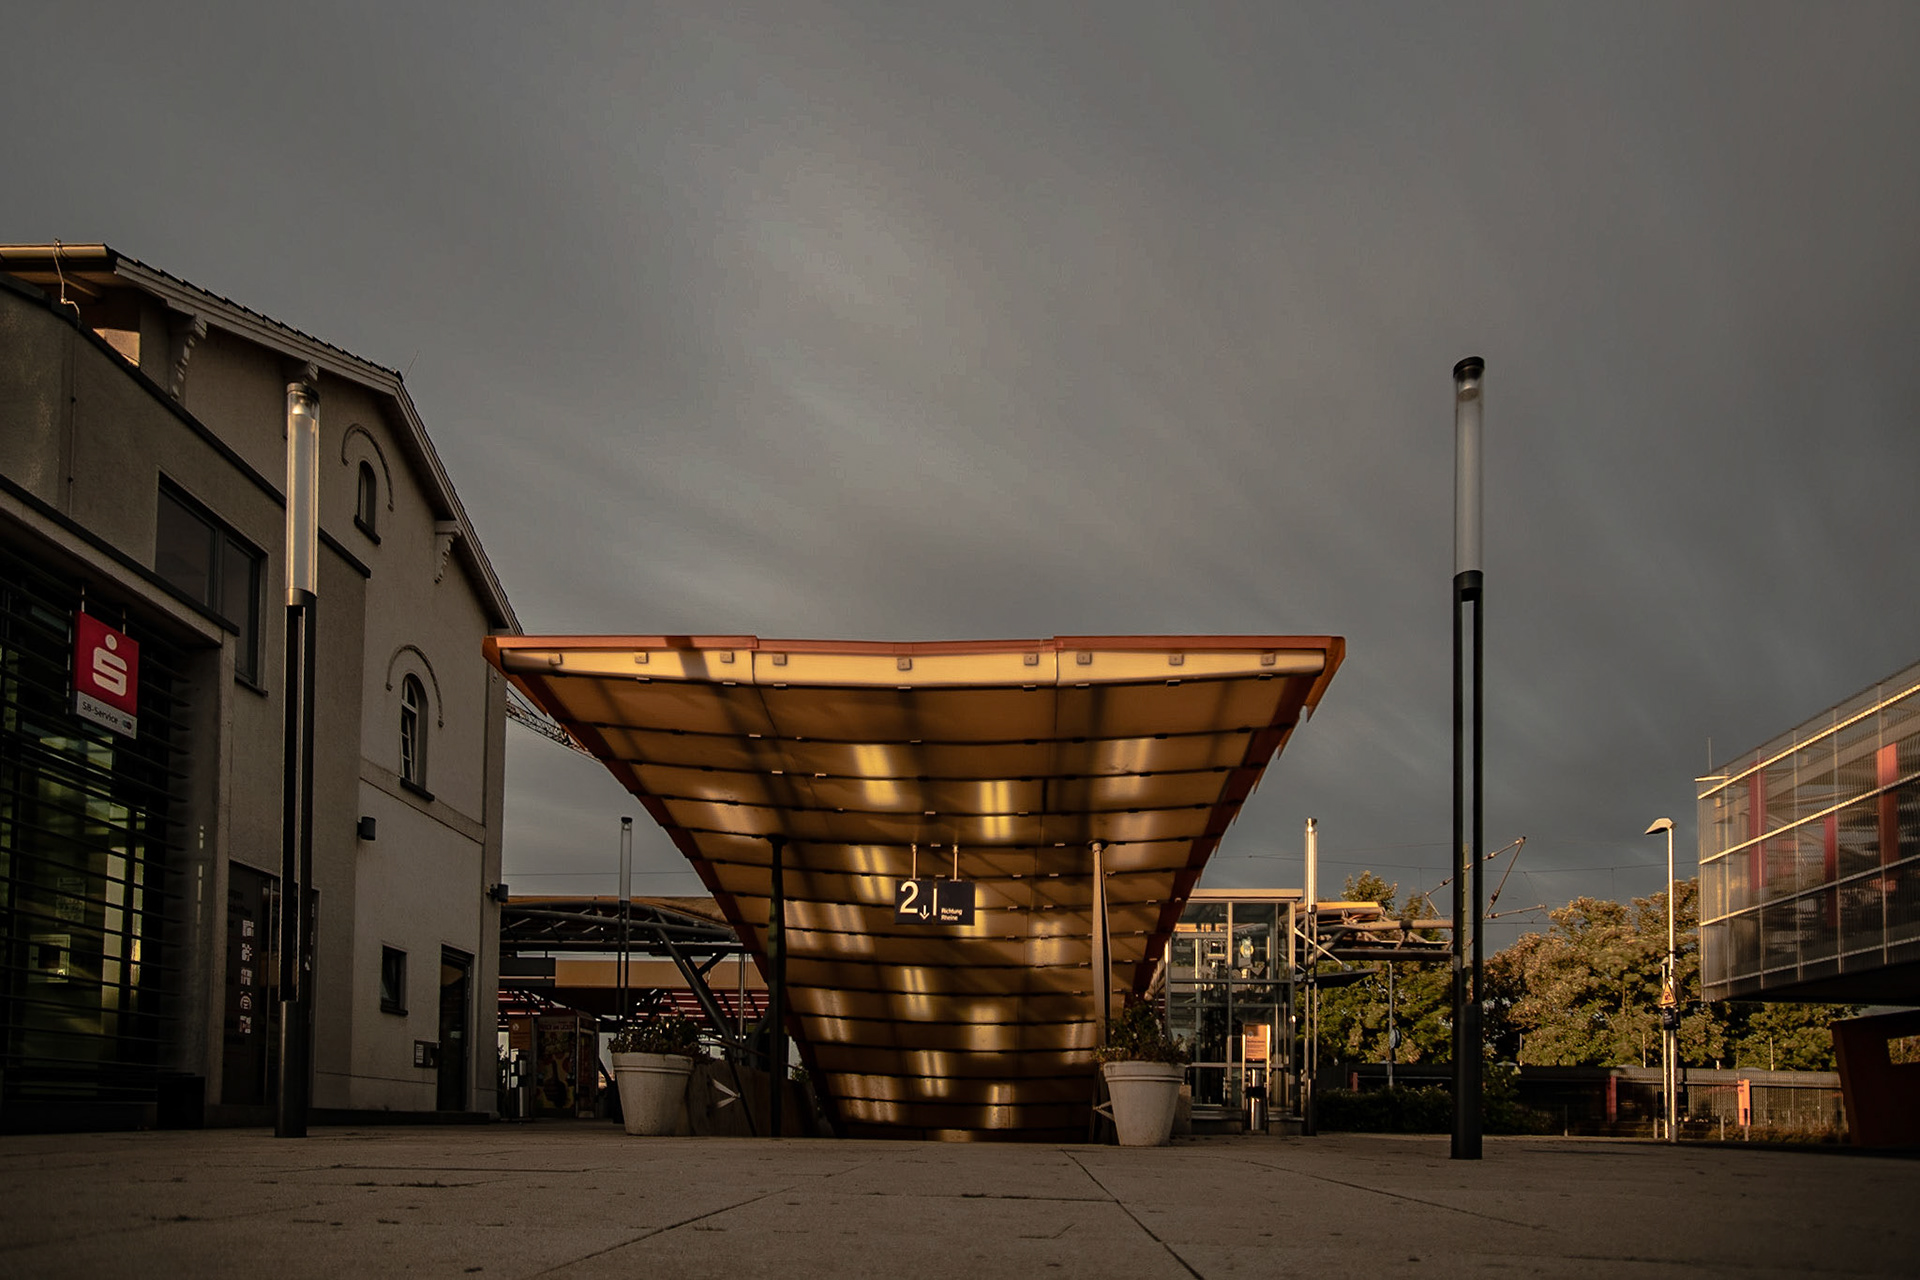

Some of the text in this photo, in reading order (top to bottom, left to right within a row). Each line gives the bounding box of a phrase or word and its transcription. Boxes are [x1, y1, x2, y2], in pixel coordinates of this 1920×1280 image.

[82, 701, 119, 724] SB-Service
[899, 881, 919, 914] 2
[941, 907, 963, 916] Richtung
